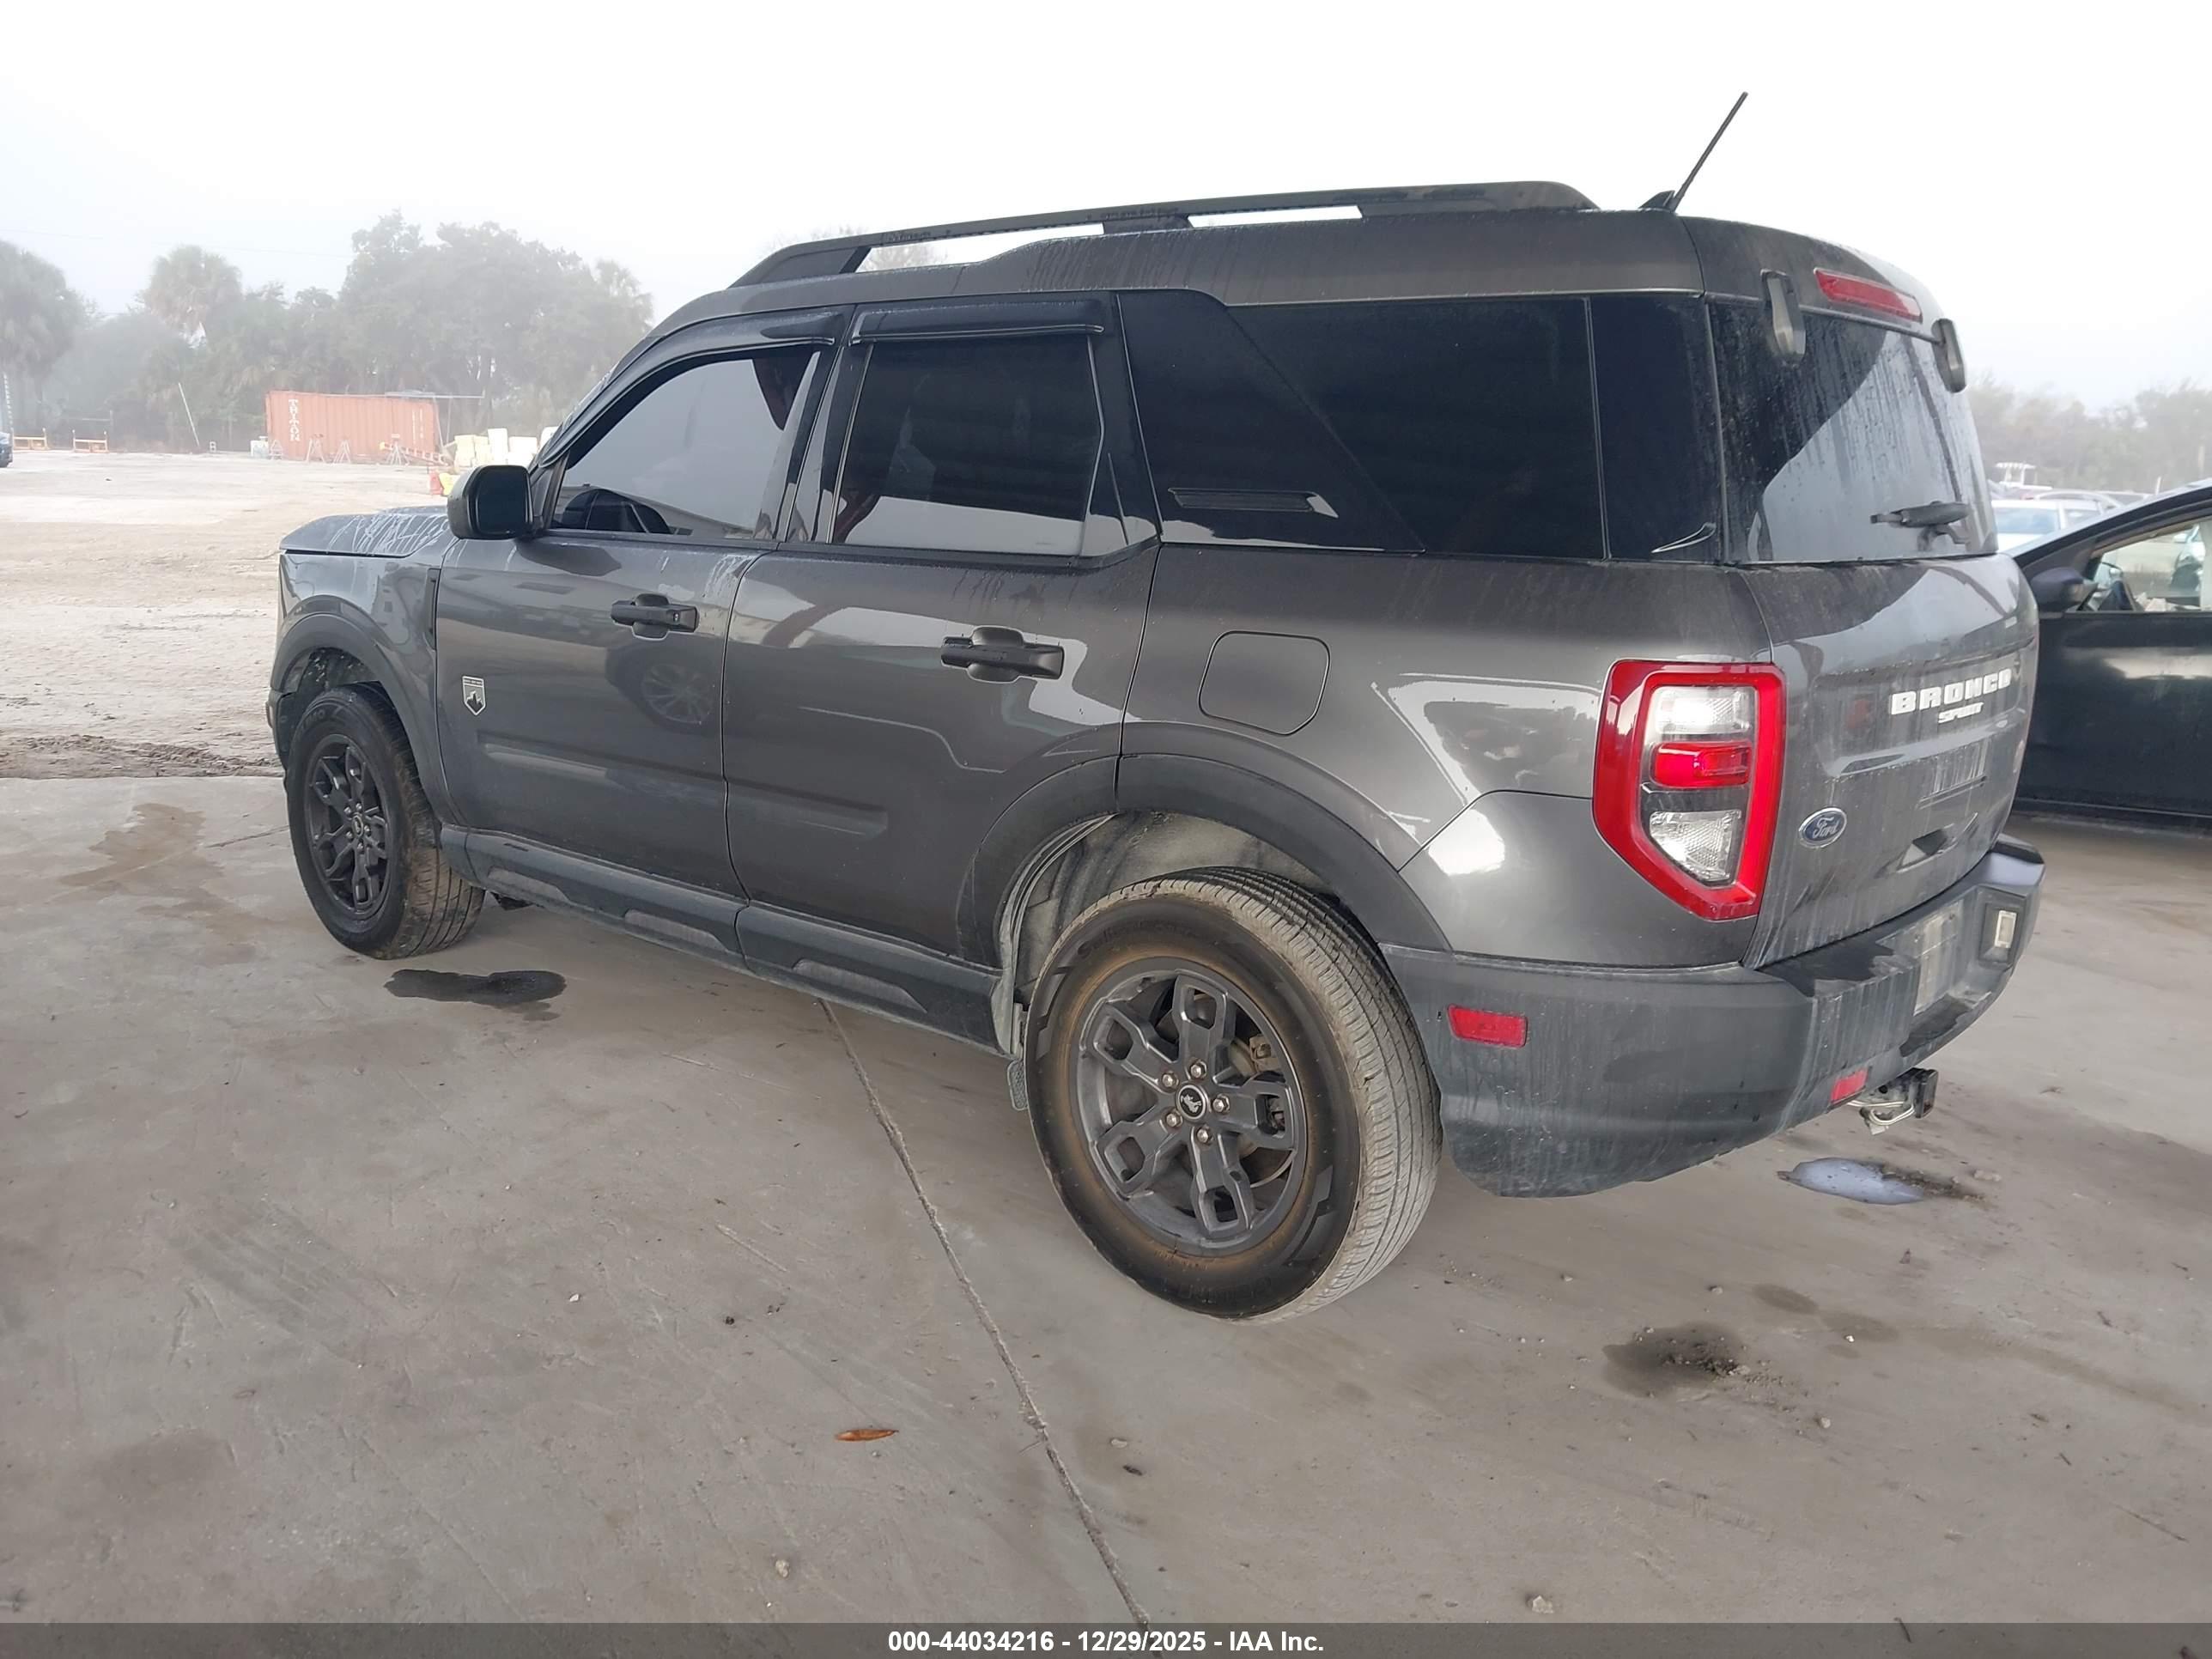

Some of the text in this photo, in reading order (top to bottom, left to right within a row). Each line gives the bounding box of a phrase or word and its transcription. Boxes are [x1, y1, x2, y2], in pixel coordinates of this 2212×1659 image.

[288, 398, 301, 442] TRITON
[1891, 668, 2012, 715] BRONCO
[1812, 816, 1841, 839] Ford
